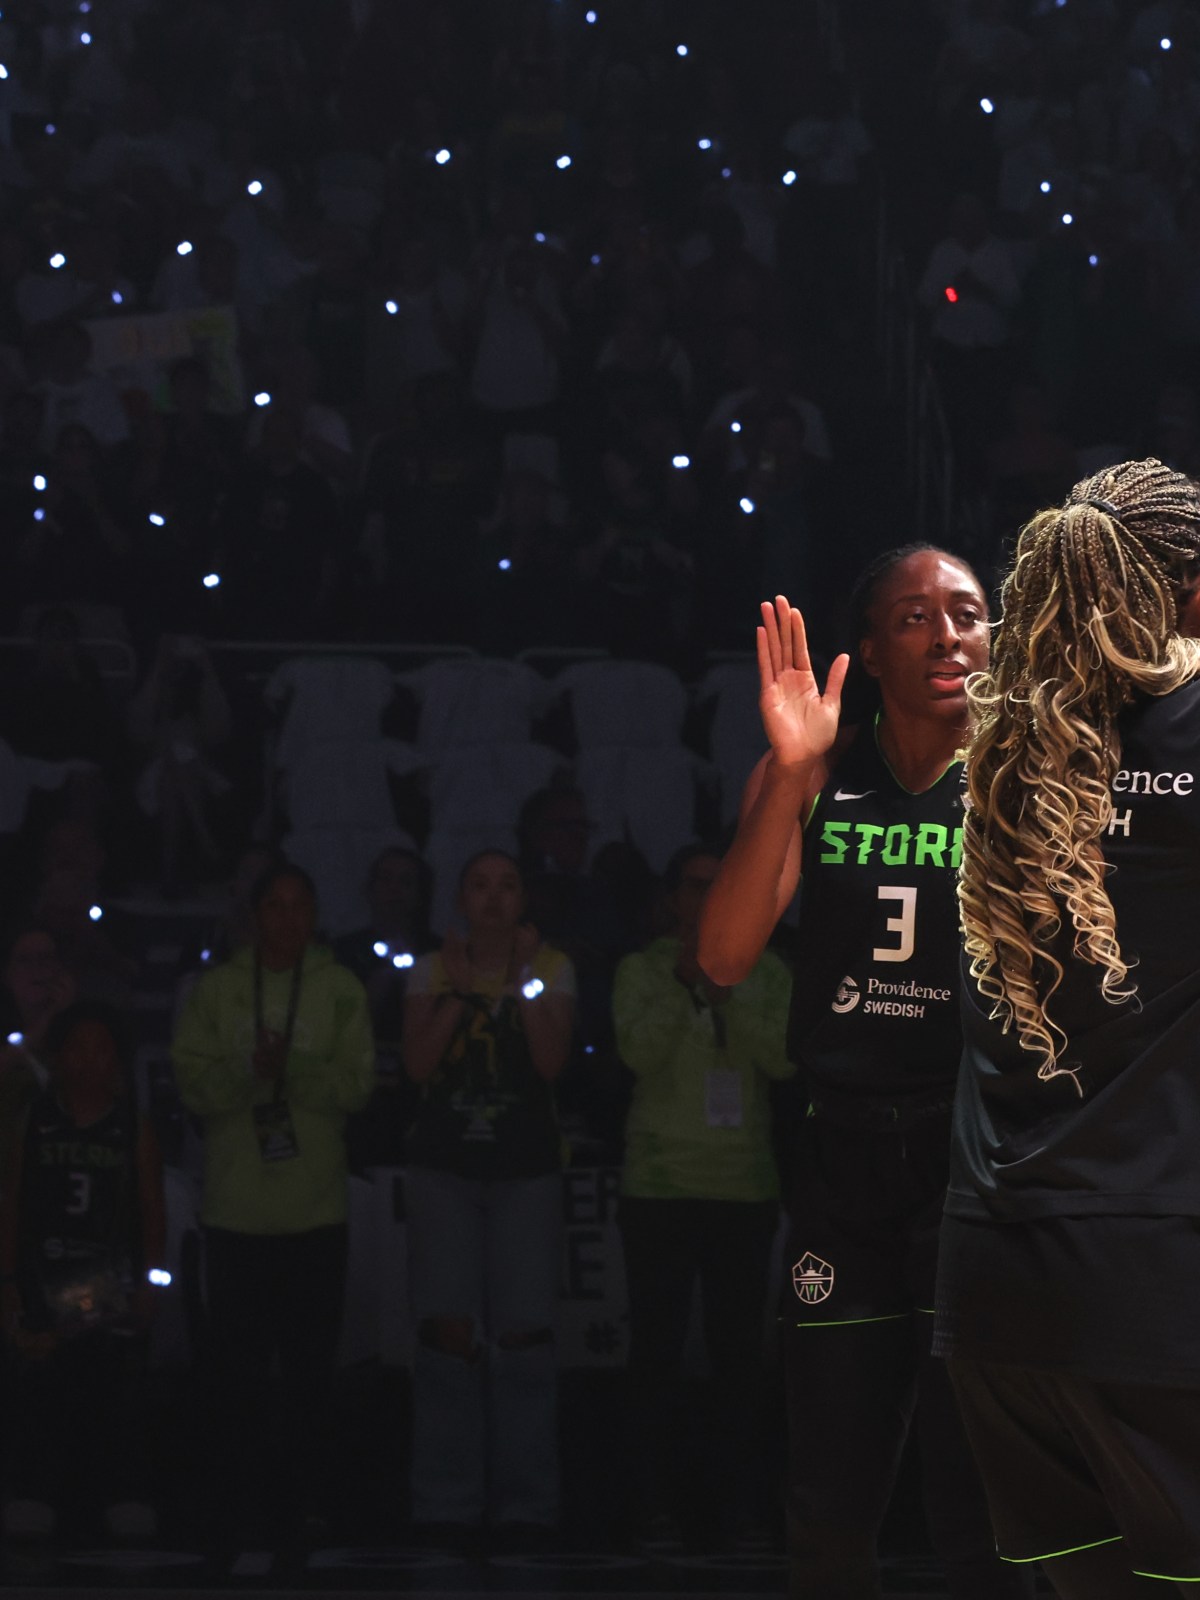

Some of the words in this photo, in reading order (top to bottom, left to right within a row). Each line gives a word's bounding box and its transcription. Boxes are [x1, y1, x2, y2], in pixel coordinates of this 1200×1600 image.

[872, 886, 918, 963] 3
[866, 978, 951, 1001] Providence
[863, 1001, 925, 1018] SWEDISH
[65, 1173, 91, 1216] 3
